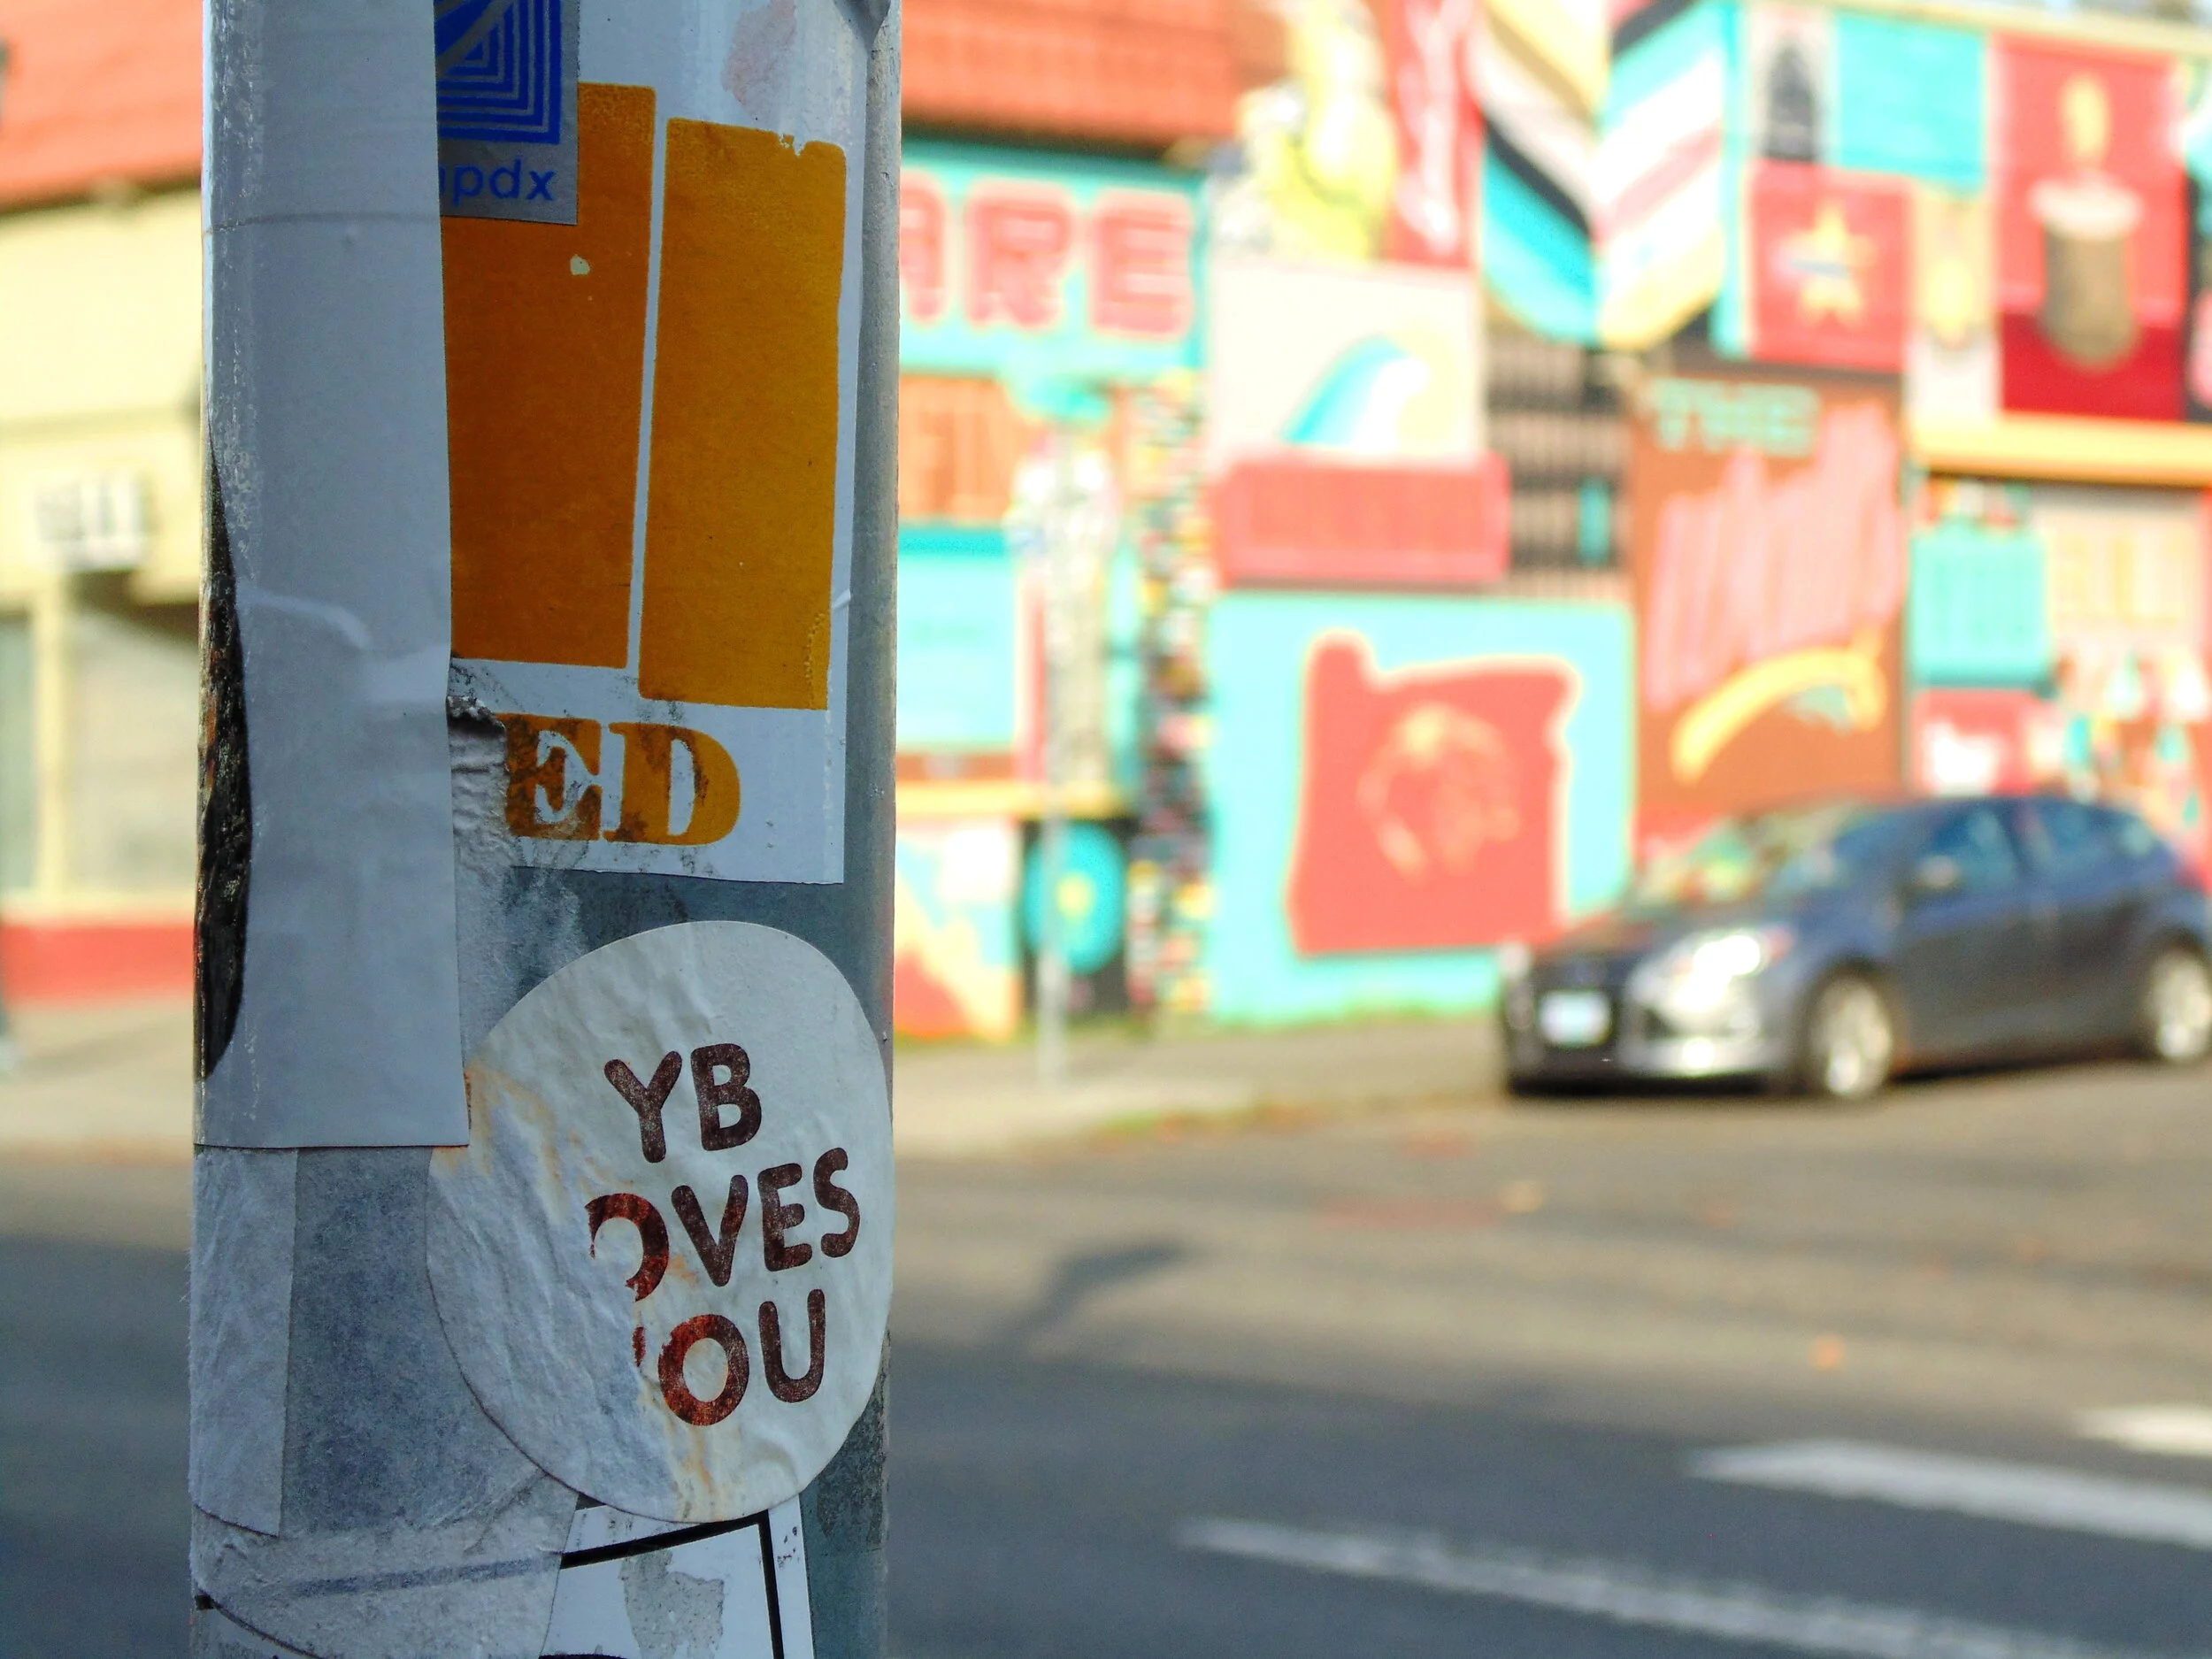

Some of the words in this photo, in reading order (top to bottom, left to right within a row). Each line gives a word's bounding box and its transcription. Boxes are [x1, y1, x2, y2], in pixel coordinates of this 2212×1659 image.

[494, 712, 741, 847] ED
[603, 1043, 762, 1163] YB
[632, 1289, 826, 1426] OU
